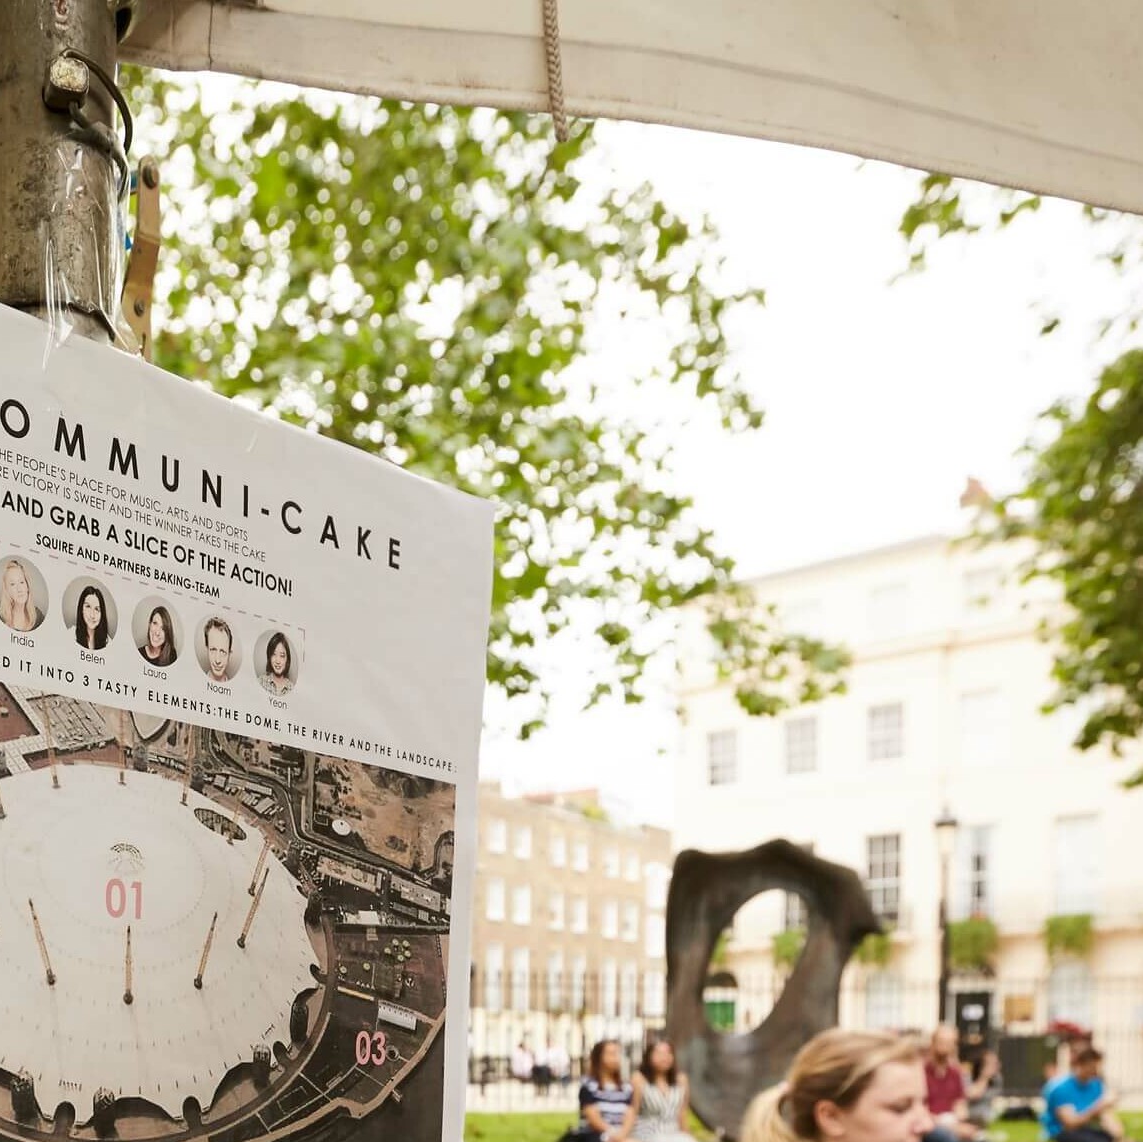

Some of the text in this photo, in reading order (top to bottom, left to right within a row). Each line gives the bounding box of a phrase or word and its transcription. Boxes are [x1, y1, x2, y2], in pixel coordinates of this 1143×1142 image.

[11, 469, 60, 495] VICTORY
[62, 485, 72, 500] IS
[72, 489, 107, 511] SWEET
[107, 500, 135, 521] AND
[133, 509, 153, 527] THE
[153, 515, 194, 540] WINNER
[193, 528, 222, 548] TAKES
[222, 538, 241, 556] THE
[240, 544, 266, 562] CAKE
[14, 453, 68, 483] PEOPLE'S
[68, 471, 104, 495] PLACE
[105, 484, 128, 502] FOR
[128, 493, 164, 516] MUSIC,
[165, 506, 190, 524] ARTS
[190, 513, 213, 531] AND
[213, 521, 248, 542] SPORTS
[1, 490, 43, 518] AND
[50, 506, 100, 537] GRAB
[106, 524, 119, 544] A
[124, 529, 169, 558] SLICE
[173, 545, 195, 566] OF
[199, 552, 226, 576] THE
[230, 563, 292, 597] ACTION!
[36, 534, 220, 598] SQUIRE AND PARTNERS BAKING-TEAM
[10, 633, 35, 648] India
[80, 650, 106, 666] Belen
[143, 666, 168, 680] Laura
[206, 681, 232, 696] Noam
[20, 660, 31, 673] IT
[41, 664, 74, 683] INTO
[82, 675, 89, 686] 3
[98, 678, 137, 698] TASTY
[246, 713, 281, 732] DOME,
[287, 723, 306, 737] THE
[313, 729, 344, 746] RIVER
[375, 744, 392, 756] THE
[268, 698, 288, 711] Yeon
[106, 878, 142, 920] 01
[355, 1030, 386, 1066] 03
